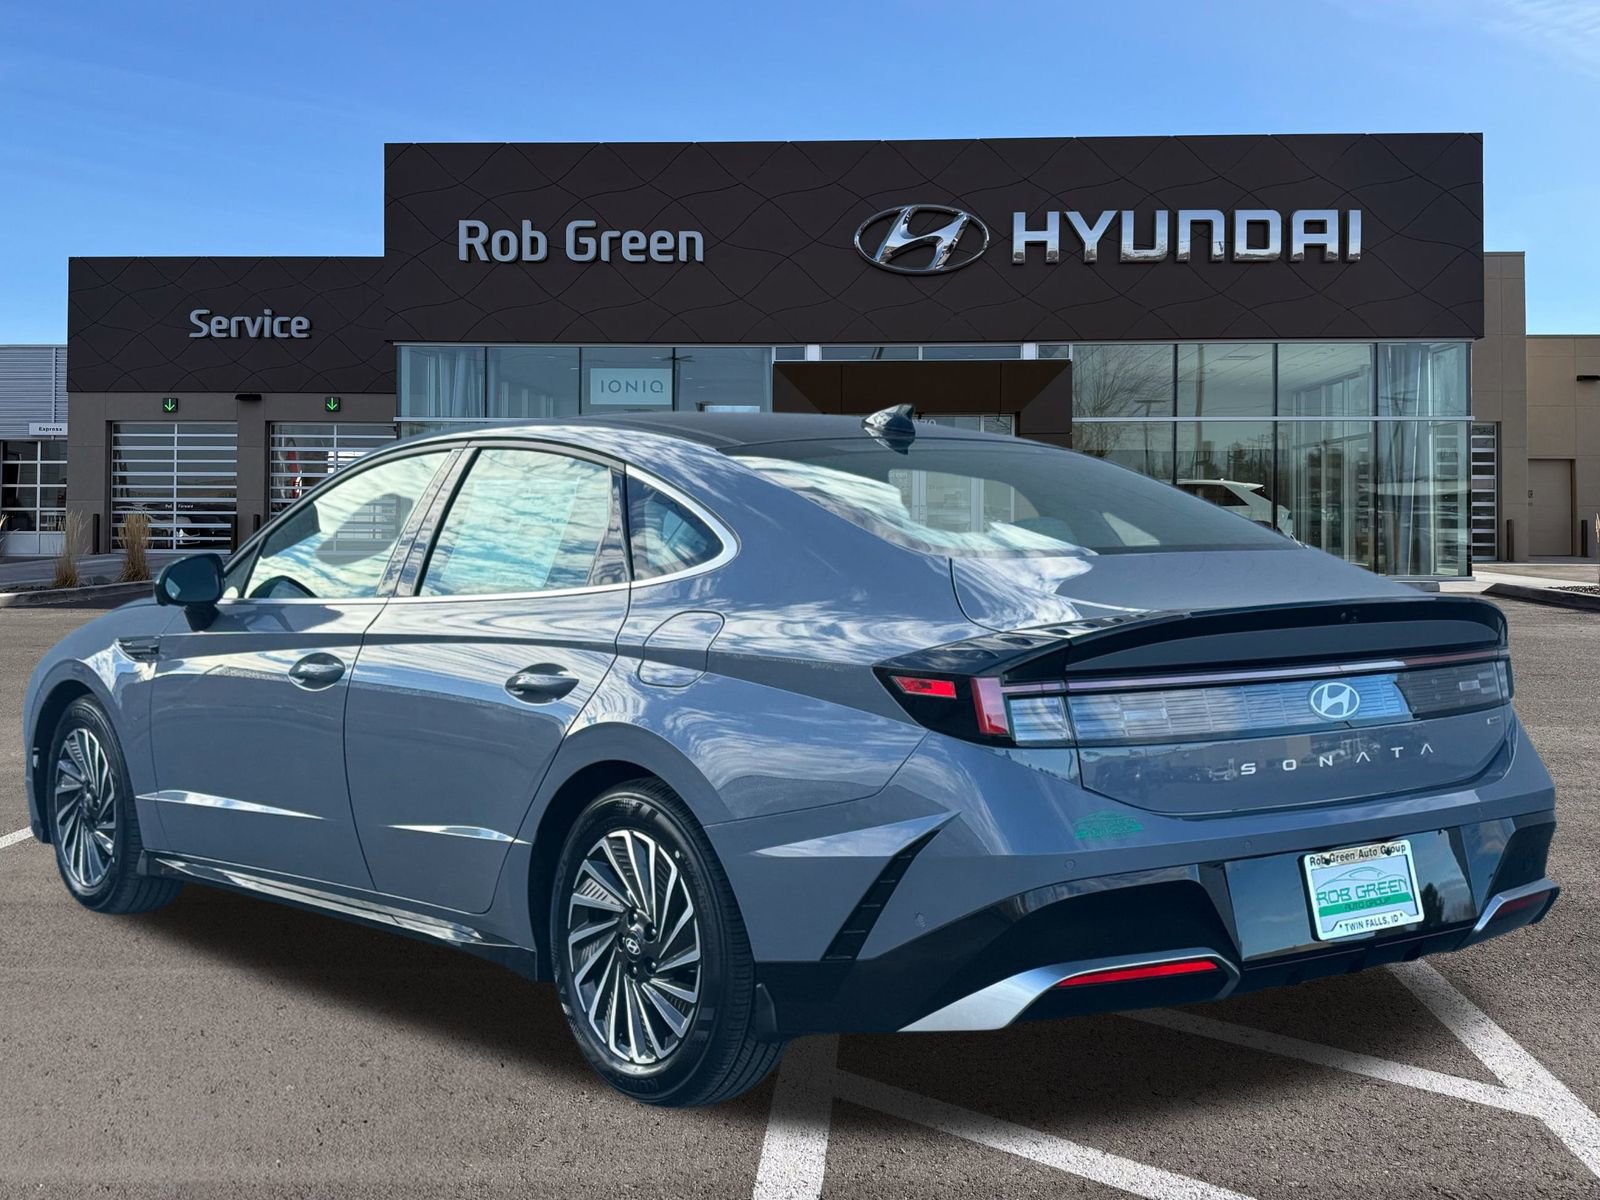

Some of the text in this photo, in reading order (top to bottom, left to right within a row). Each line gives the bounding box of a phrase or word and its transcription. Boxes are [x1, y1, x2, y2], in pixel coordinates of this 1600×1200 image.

[458, 219, 705, 263] Rob Green
[1011, 208, 1363, 264] HYUNDAI
[188, 308, 312, 339] Service
[600, 379, 665, 394] IONIQ
[1240, 742, 1434, 776] SONATA
[1309, 844, 1406, 867] Rob Green Auto Group
[1316, 879, 1408, 906] ROB GREEN
[1345, 914, 1398, 931] TWIN FALLS, ID
